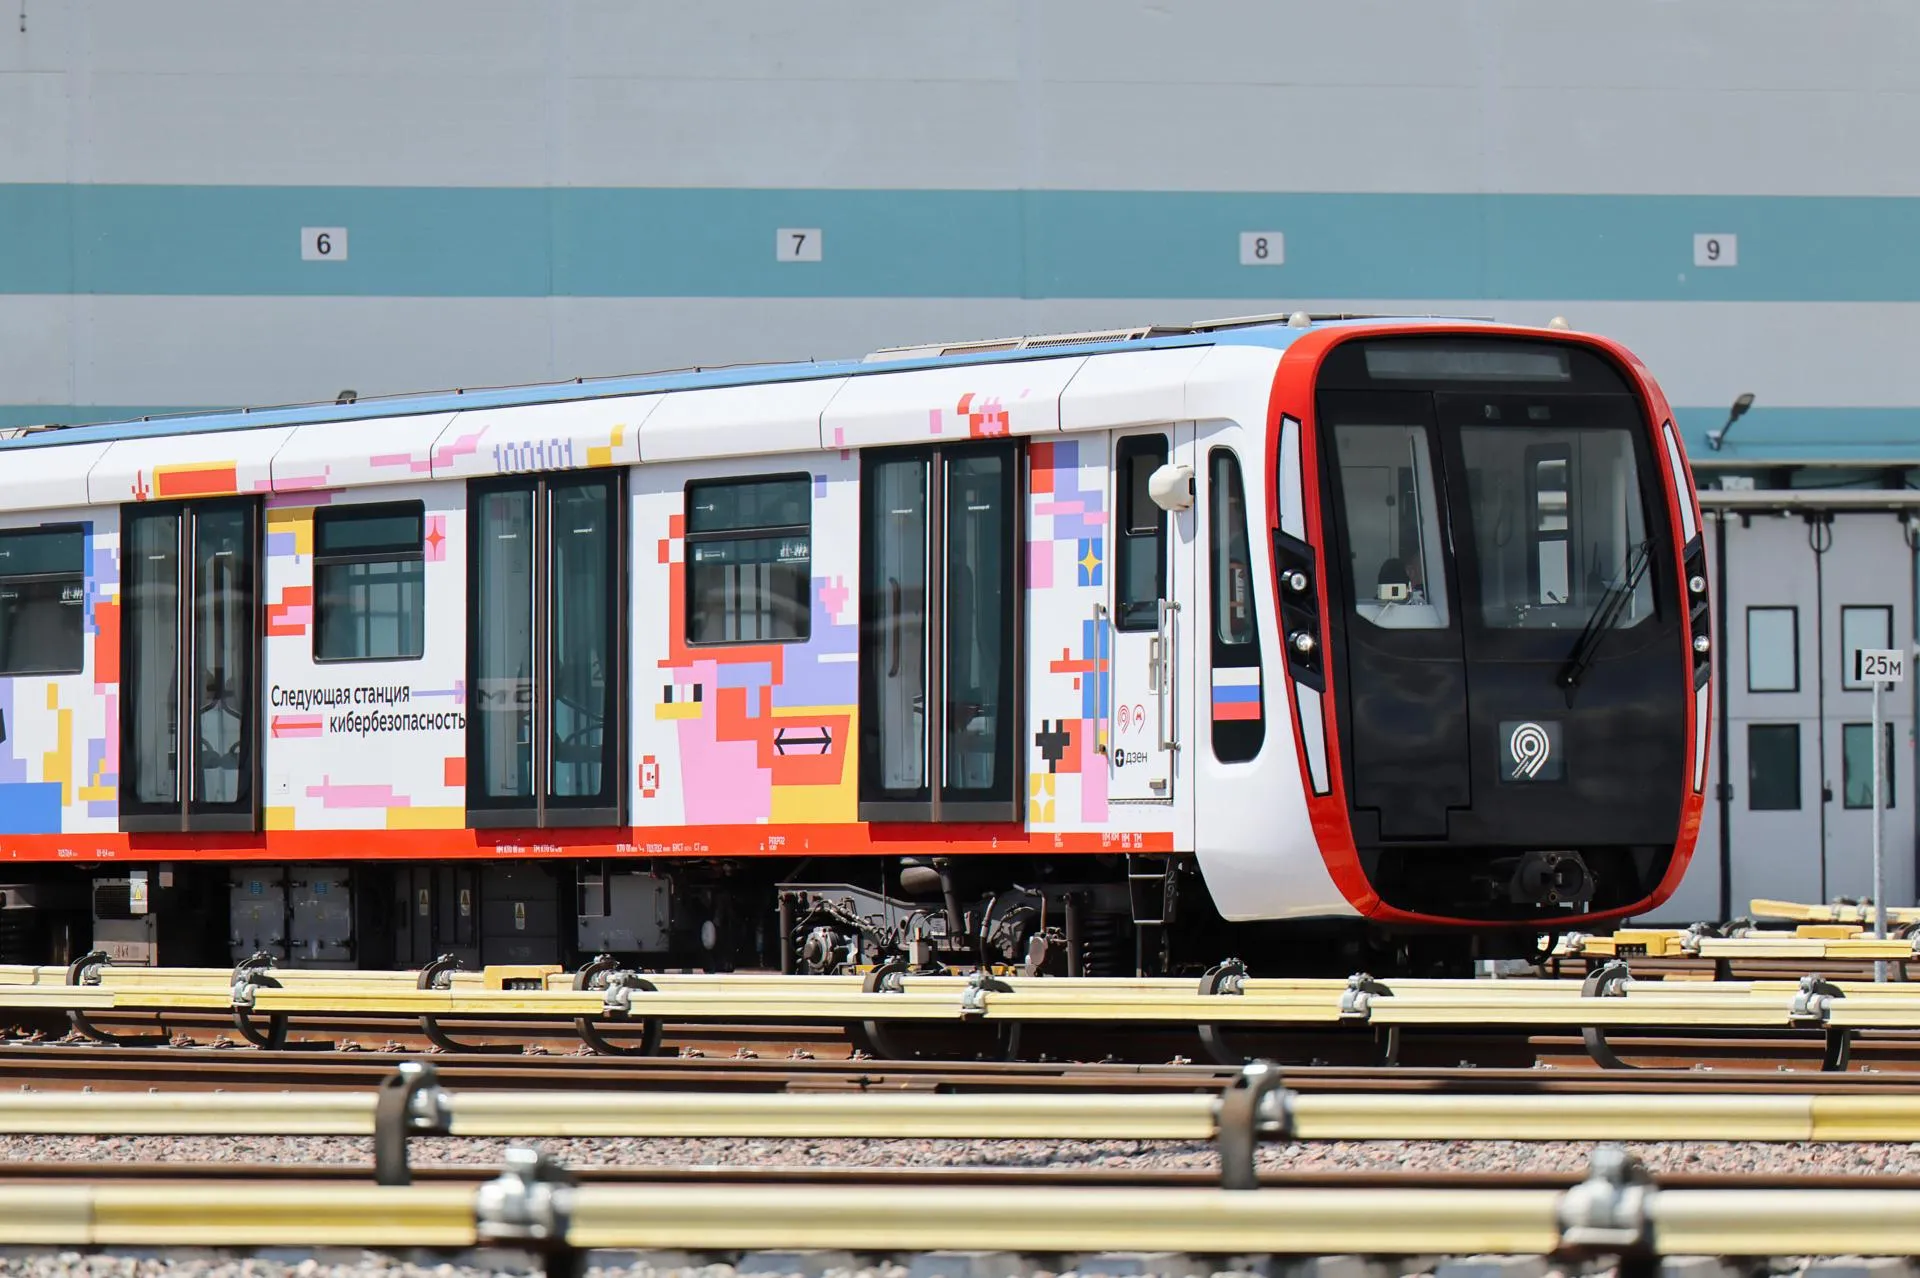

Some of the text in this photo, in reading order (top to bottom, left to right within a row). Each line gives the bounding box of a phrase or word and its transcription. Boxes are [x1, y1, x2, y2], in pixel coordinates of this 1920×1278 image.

[316, 232, 332, 255] 6
[791, 233, 807, 256] 7
[1255, 237, 1269, 259] 8
[1706, 238, 1720, 261] 9
[270, 685, 410, 711] Следующая станция
[329, 710, 466, 738] кибербезопасность
[1126, 752, 1148, 765] дзен
